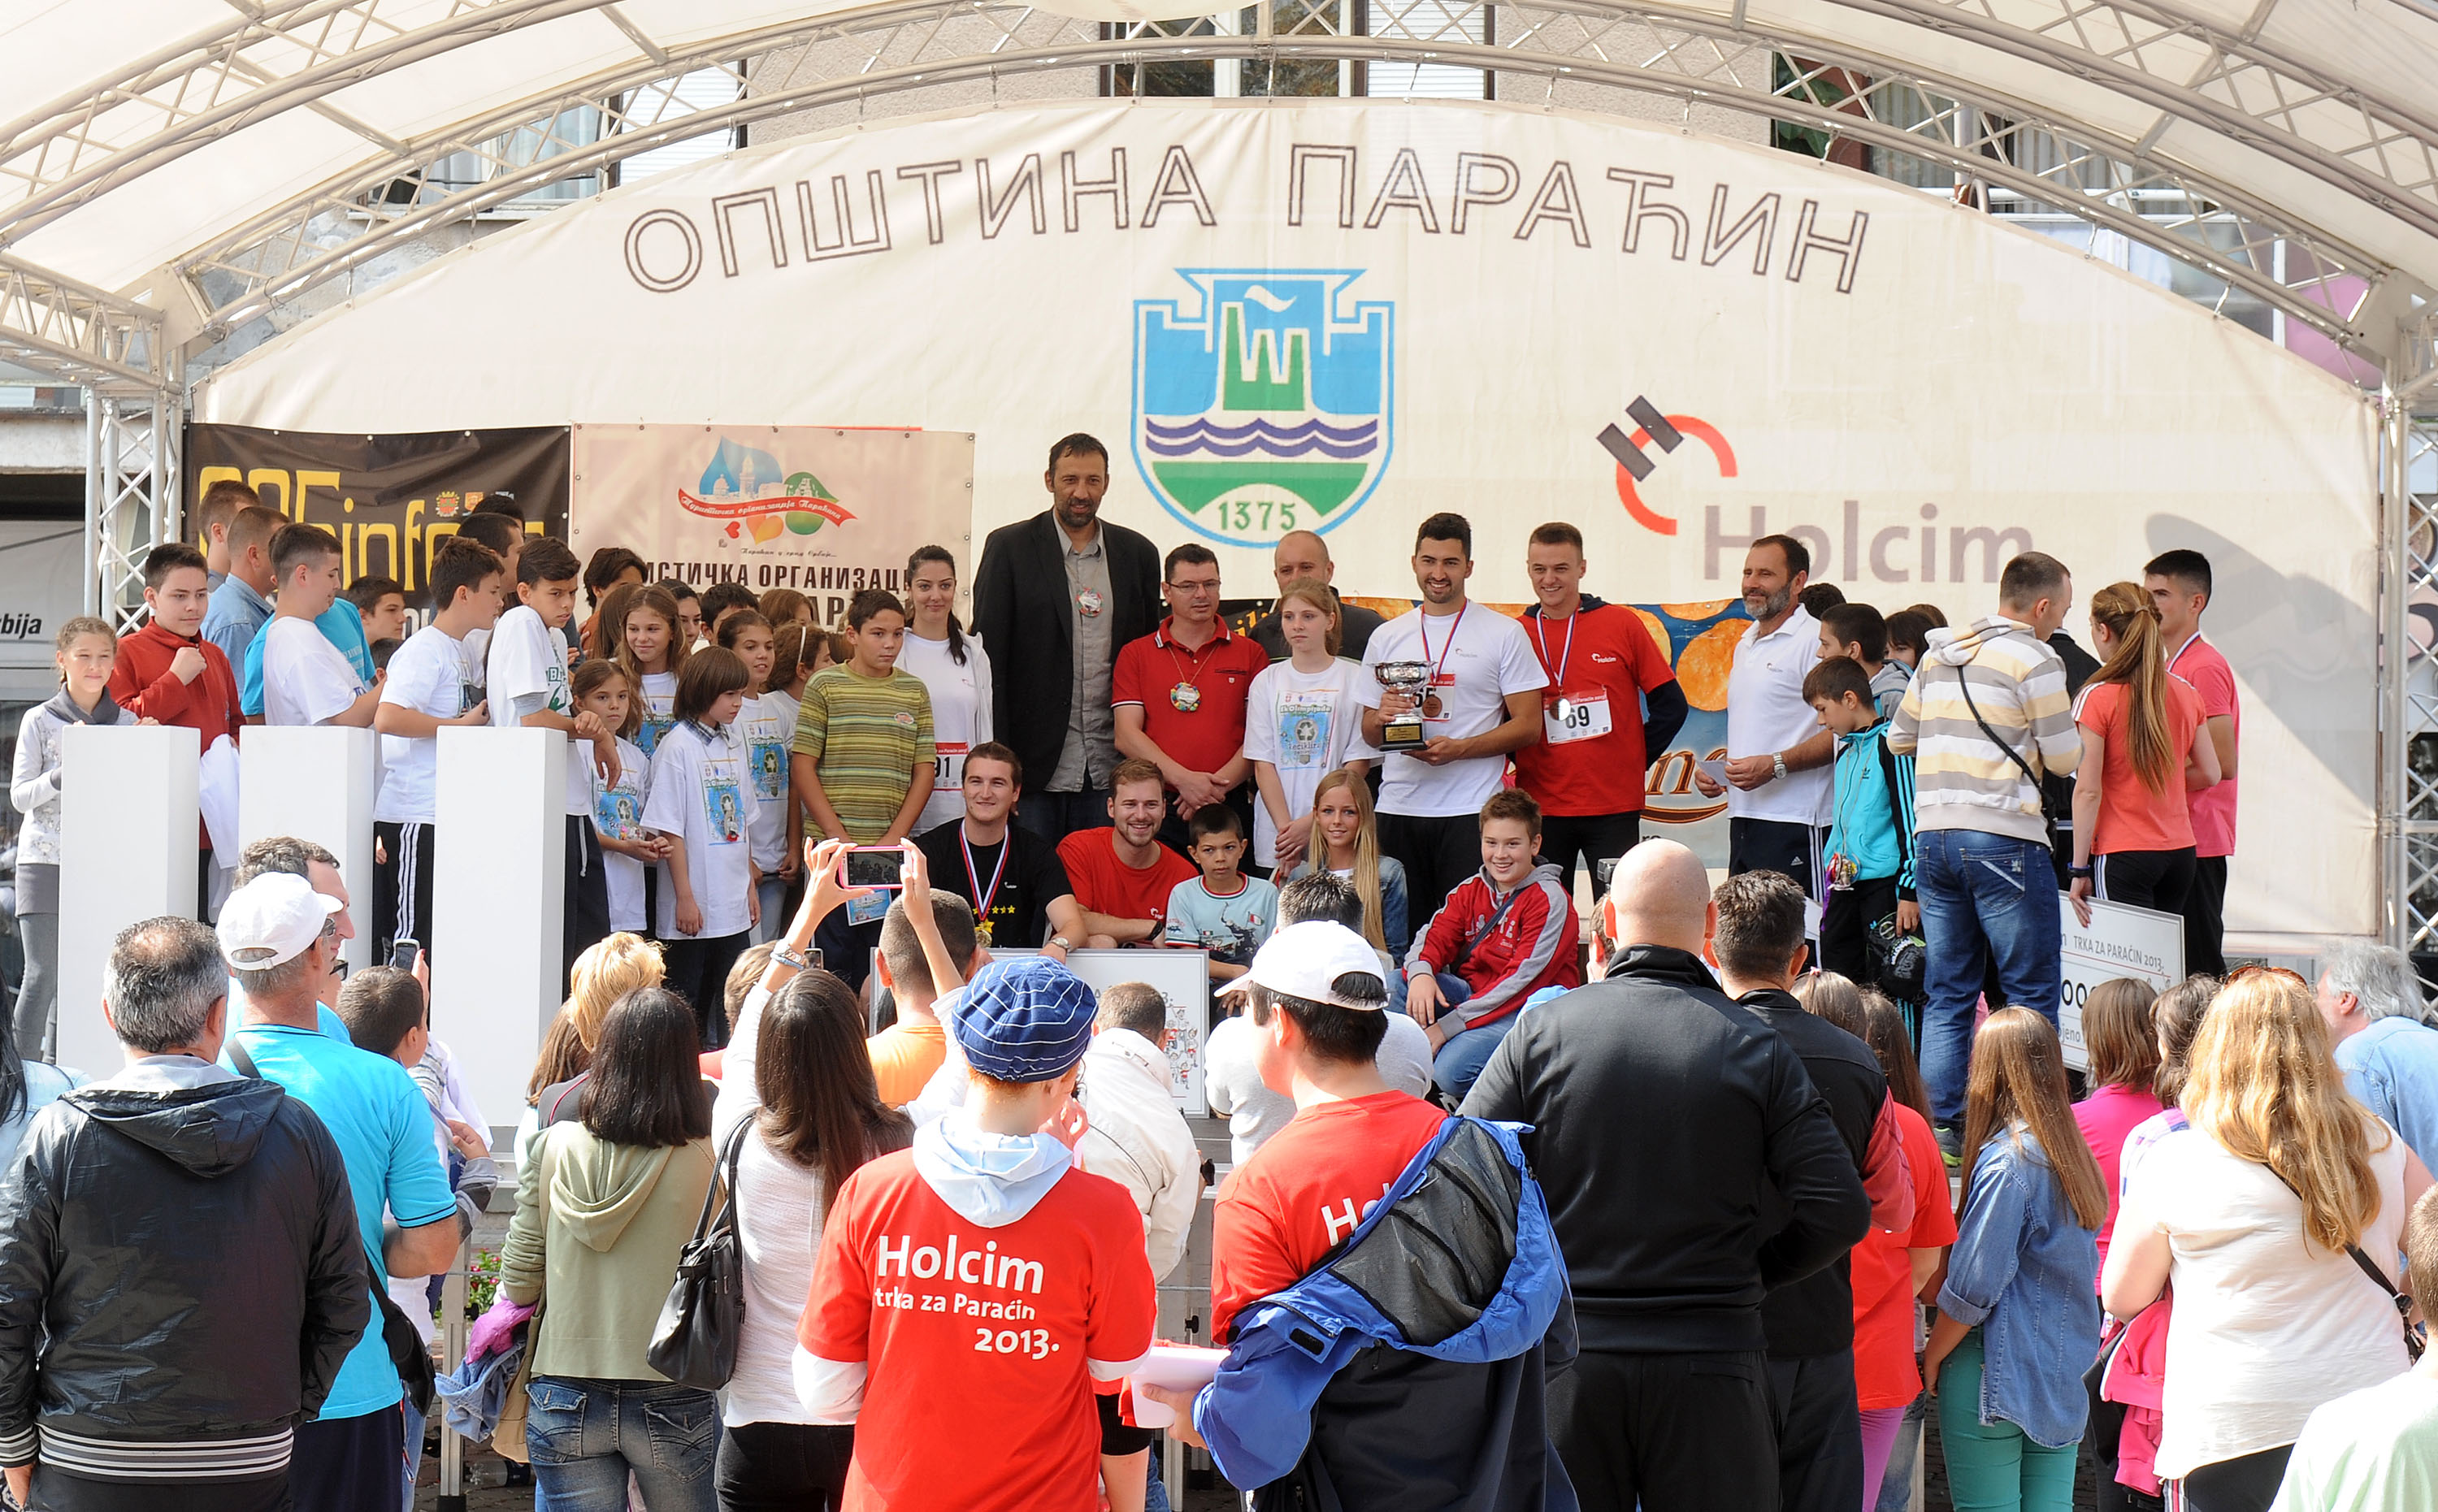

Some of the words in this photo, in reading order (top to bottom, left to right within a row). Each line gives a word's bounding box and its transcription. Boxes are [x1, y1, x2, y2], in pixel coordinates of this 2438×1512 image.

[624, 145, 1217, 293] ОПШТИНА
[1288, 144, 1870, 294] ПАРАЋИН
[1218, 501, 1296, 531] 1375
[1703, 500, 2034, 583] Holcim
[0, 613, 42, 640] bija
[1565, 705, 1590, 729] 69
[2074, 935, 2093, 952] TRKA
[2095, 940, 2106, 956] ZA
[2107, 942, 2142, 964] PARAĆIN
[876, 1233, 1044, 1294] Holcim
[874, 1286, 914, 1311] trka
[921, 1295, 947, 1313] za
[952, 1293, 1035, 1321] Paraćin
[974, 1327, 1060, 1360] 2013.
